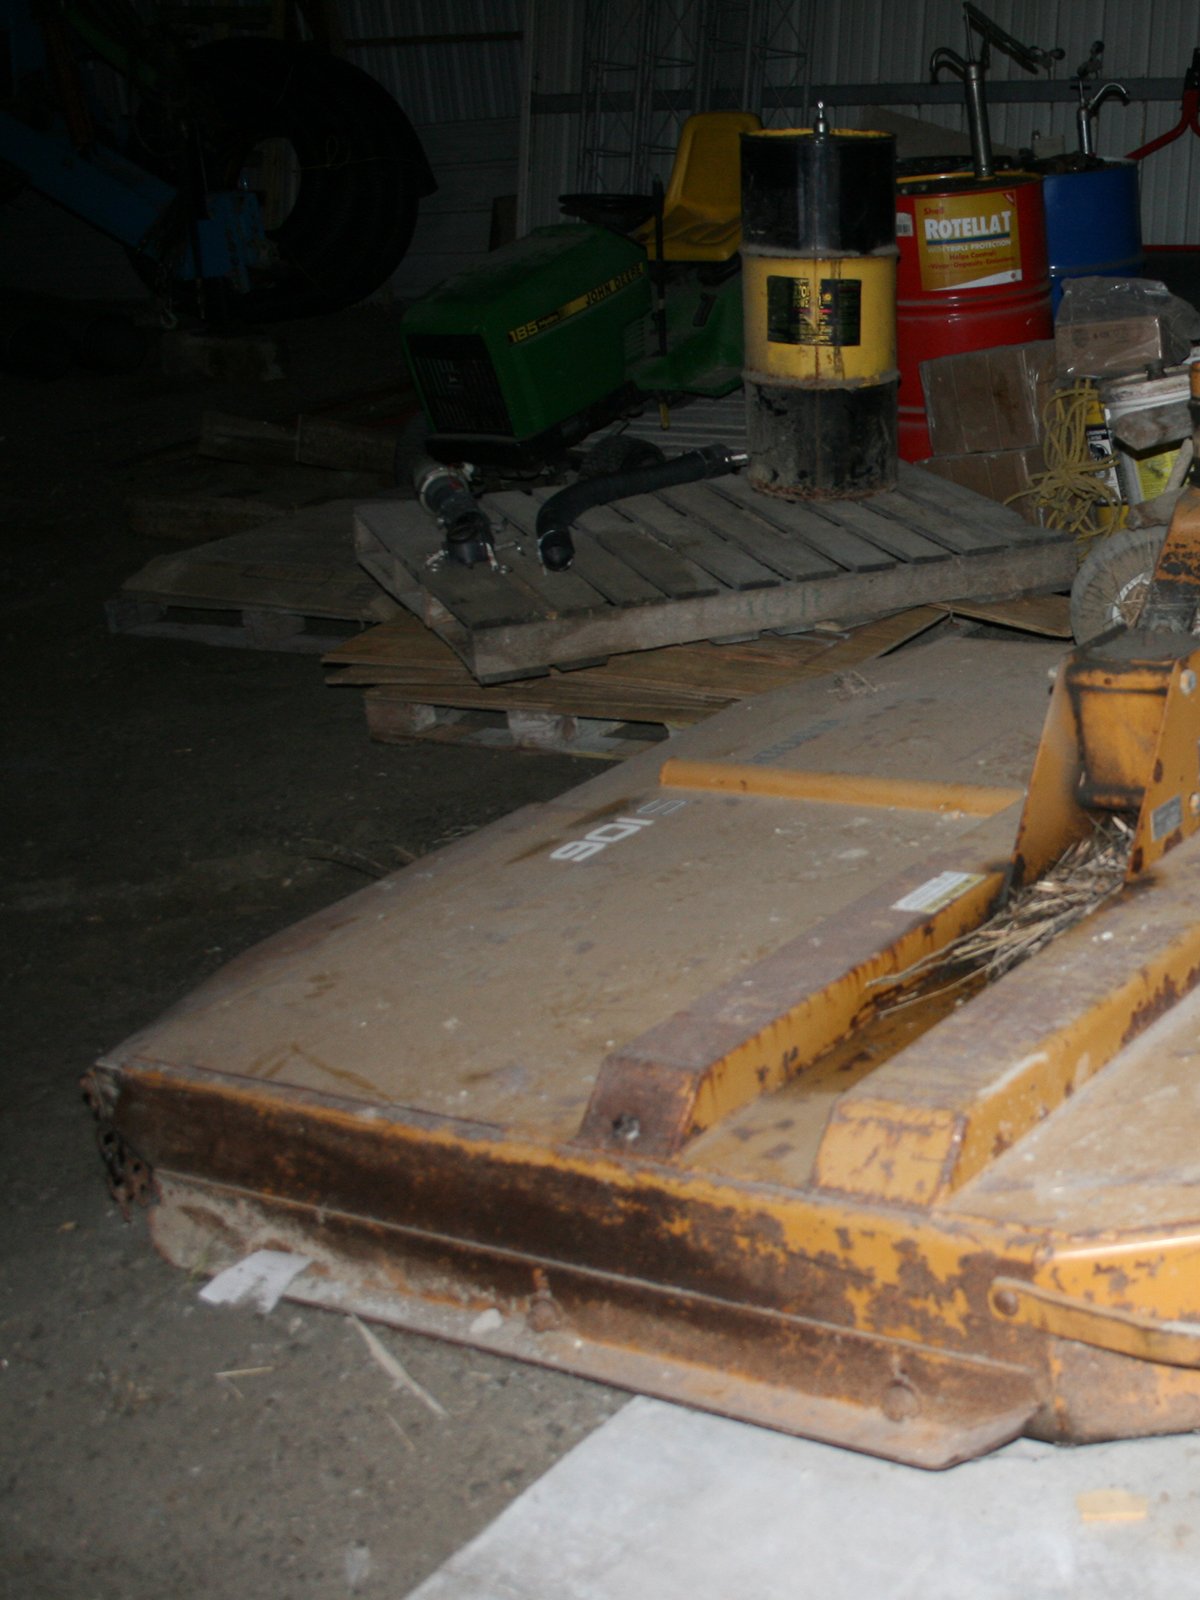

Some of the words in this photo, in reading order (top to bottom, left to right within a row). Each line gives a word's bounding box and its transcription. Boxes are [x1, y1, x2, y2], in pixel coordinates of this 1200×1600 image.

[924, 215, 1001, 240] ROTELLA
[1001, 210, 1012, 233] T
[971, 240, 1012, 250] PROTECTION
[509, 320, 539, 343] 185
[586, 283, 612, 305] JOHN
